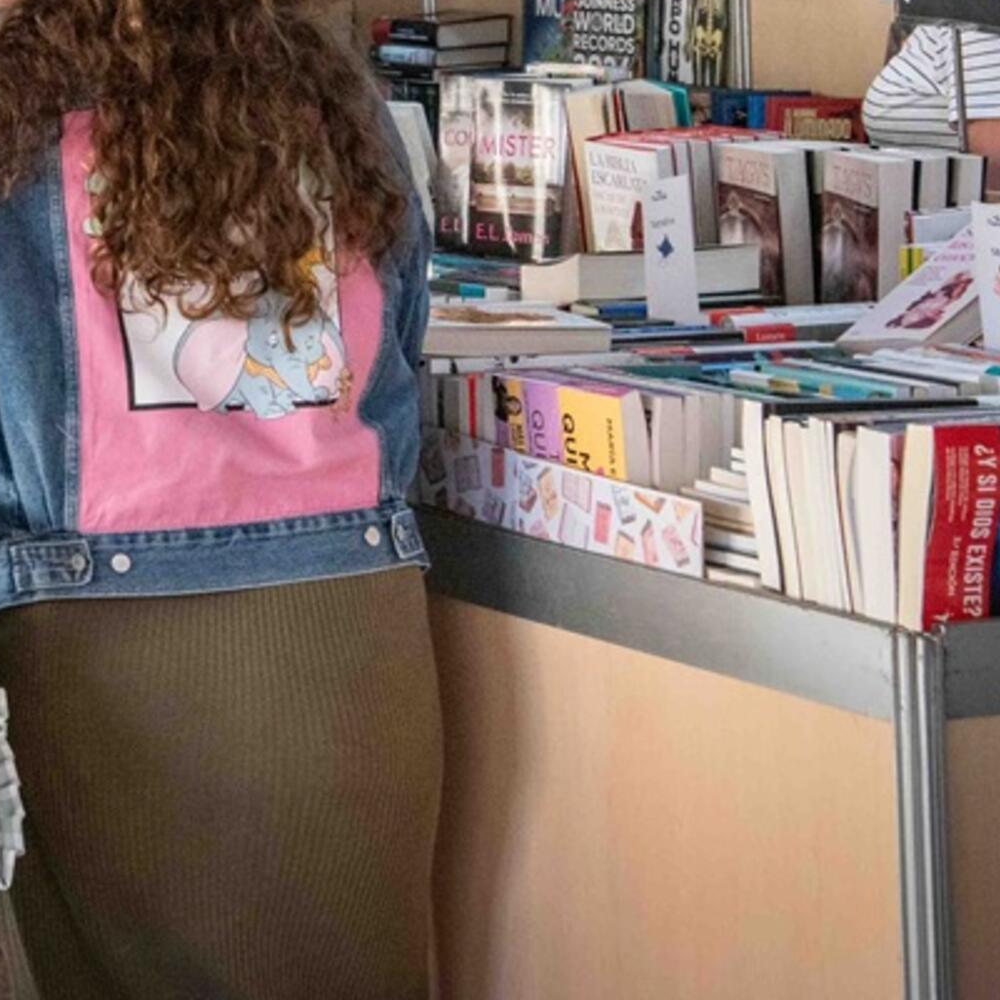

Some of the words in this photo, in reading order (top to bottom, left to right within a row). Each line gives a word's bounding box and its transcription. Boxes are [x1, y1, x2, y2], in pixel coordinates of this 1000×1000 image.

[573, 10, 636, 34] WORLD
[572, 33, 636, 54] RECORDS
[480, 132, 556, 160] MISTER
[973, 444, 998, 468] ¿Y
[976, 474, 998, 492] SI
[969, 498, 996, 539] DIOS
[963, 545, 987, 617] EXISTE?
